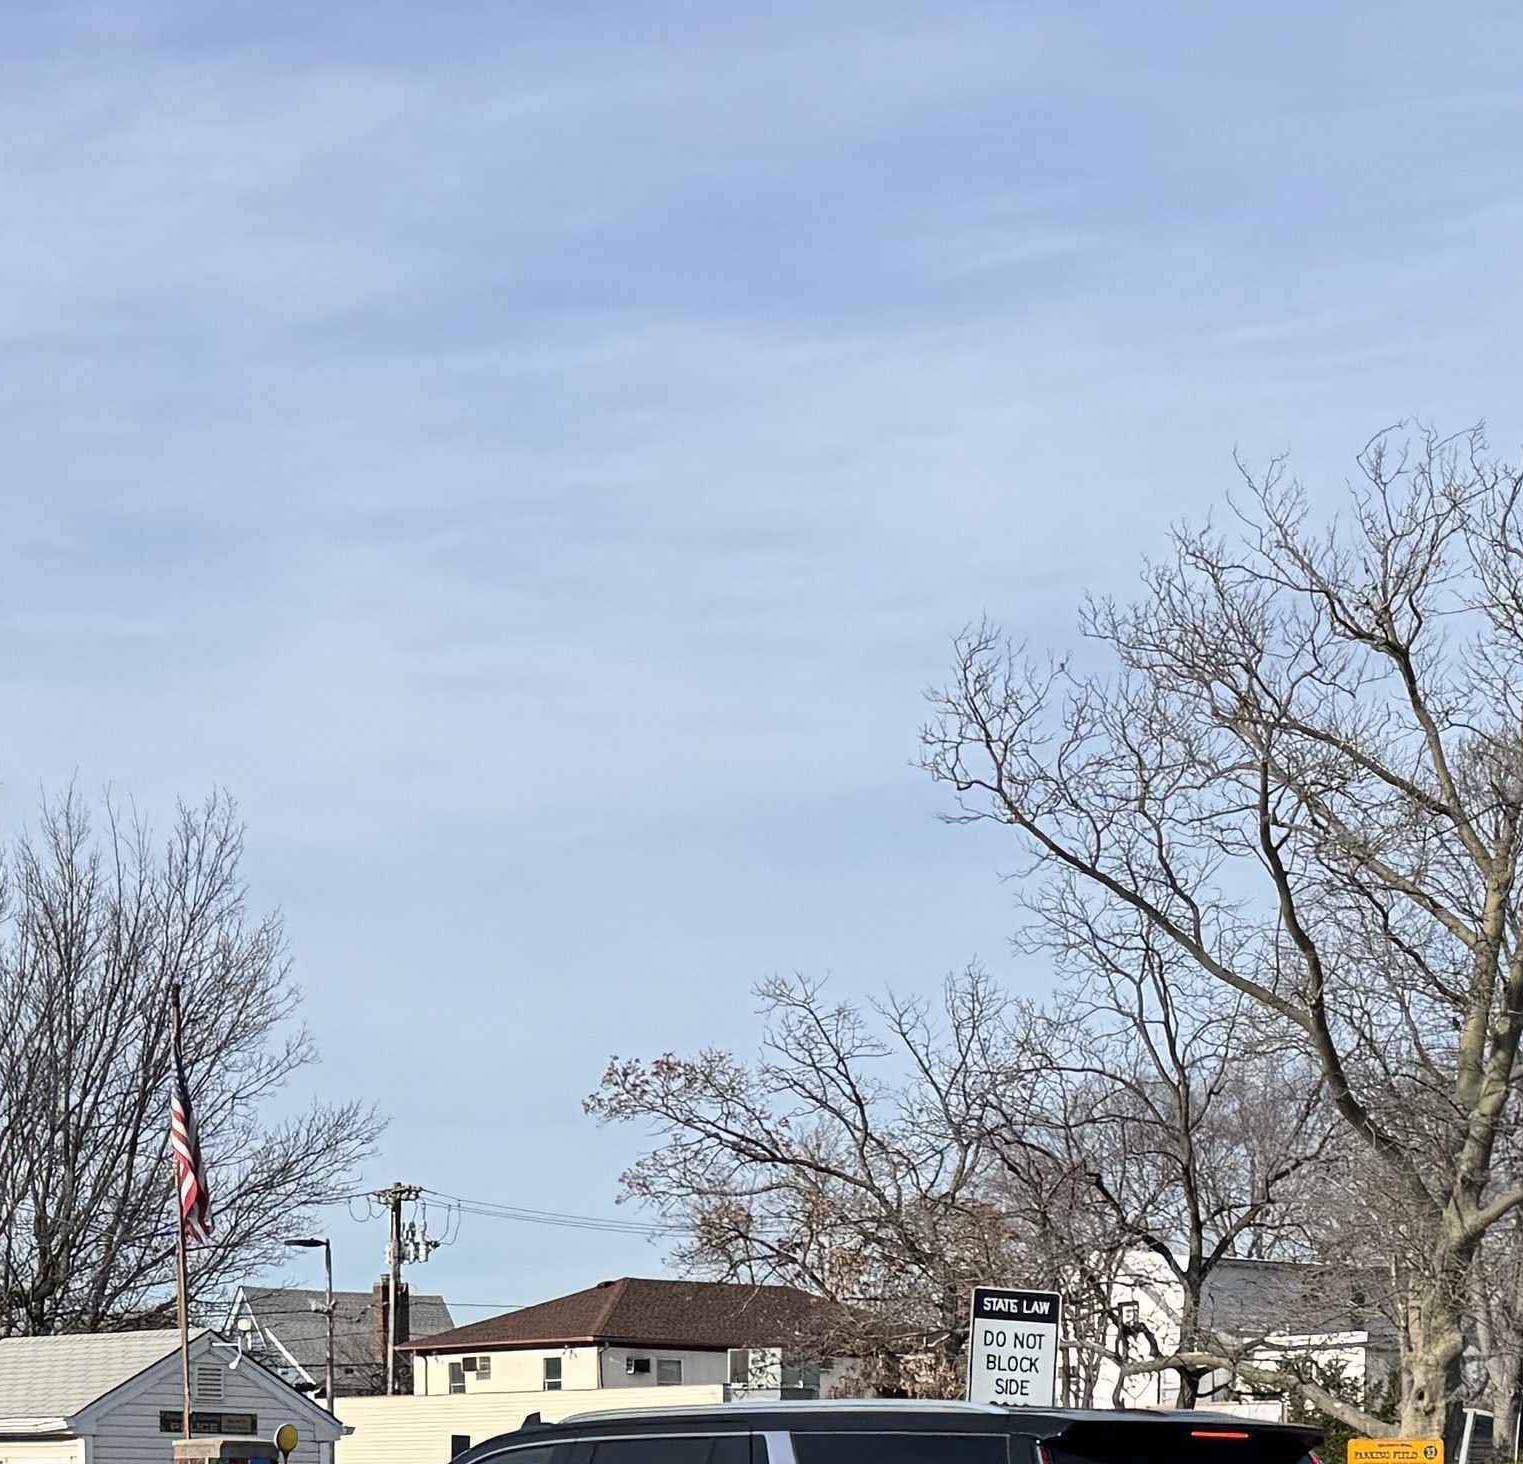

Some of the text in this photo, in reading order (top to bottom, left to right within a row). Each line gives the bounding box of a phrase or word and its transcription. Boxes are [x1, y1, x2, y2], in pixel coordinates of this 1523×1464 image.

[983, 1297, 1050, 1315] STATE LAW
[983, 1330, 1045, 1350] DO NOT
[986, 1354, 1039, 1373] BLOCK
[995, 1378, 1030, 1396] SIDE
